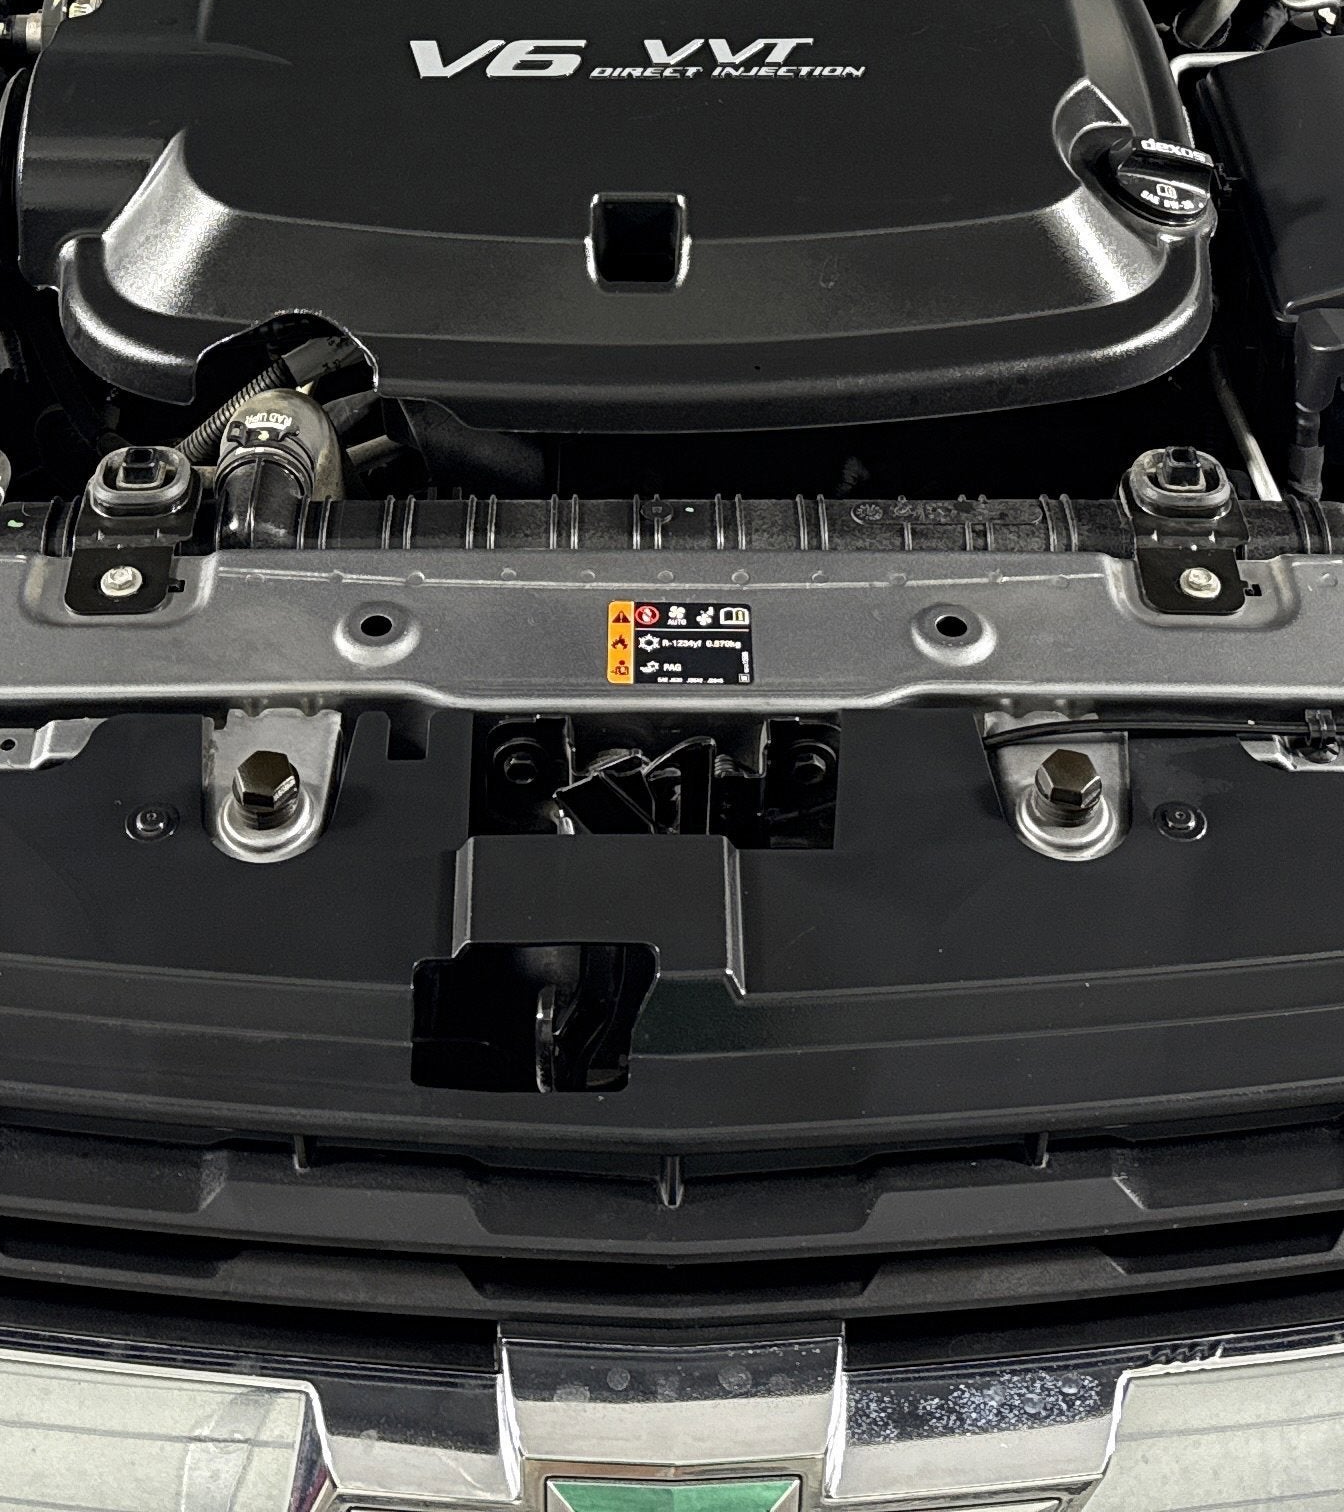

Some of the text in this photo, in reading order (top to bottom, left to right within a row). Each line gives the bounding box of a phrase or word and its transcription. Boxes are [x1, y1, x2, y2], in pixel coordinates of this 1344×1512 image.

[409, 37, 814, 79] V6 VVT
[589, 65, 866, 80] DIRECT INJECTION
[1140, 138, 1206, 163] dexos
[1140, 190, 1160, 205] SAE
[269, 413, 293, 426] RAD
[667, 618, 687, 626] AUTO
[661, 639, 702, 649] R-1234yf
[663, 663, 682, 672] PAG
